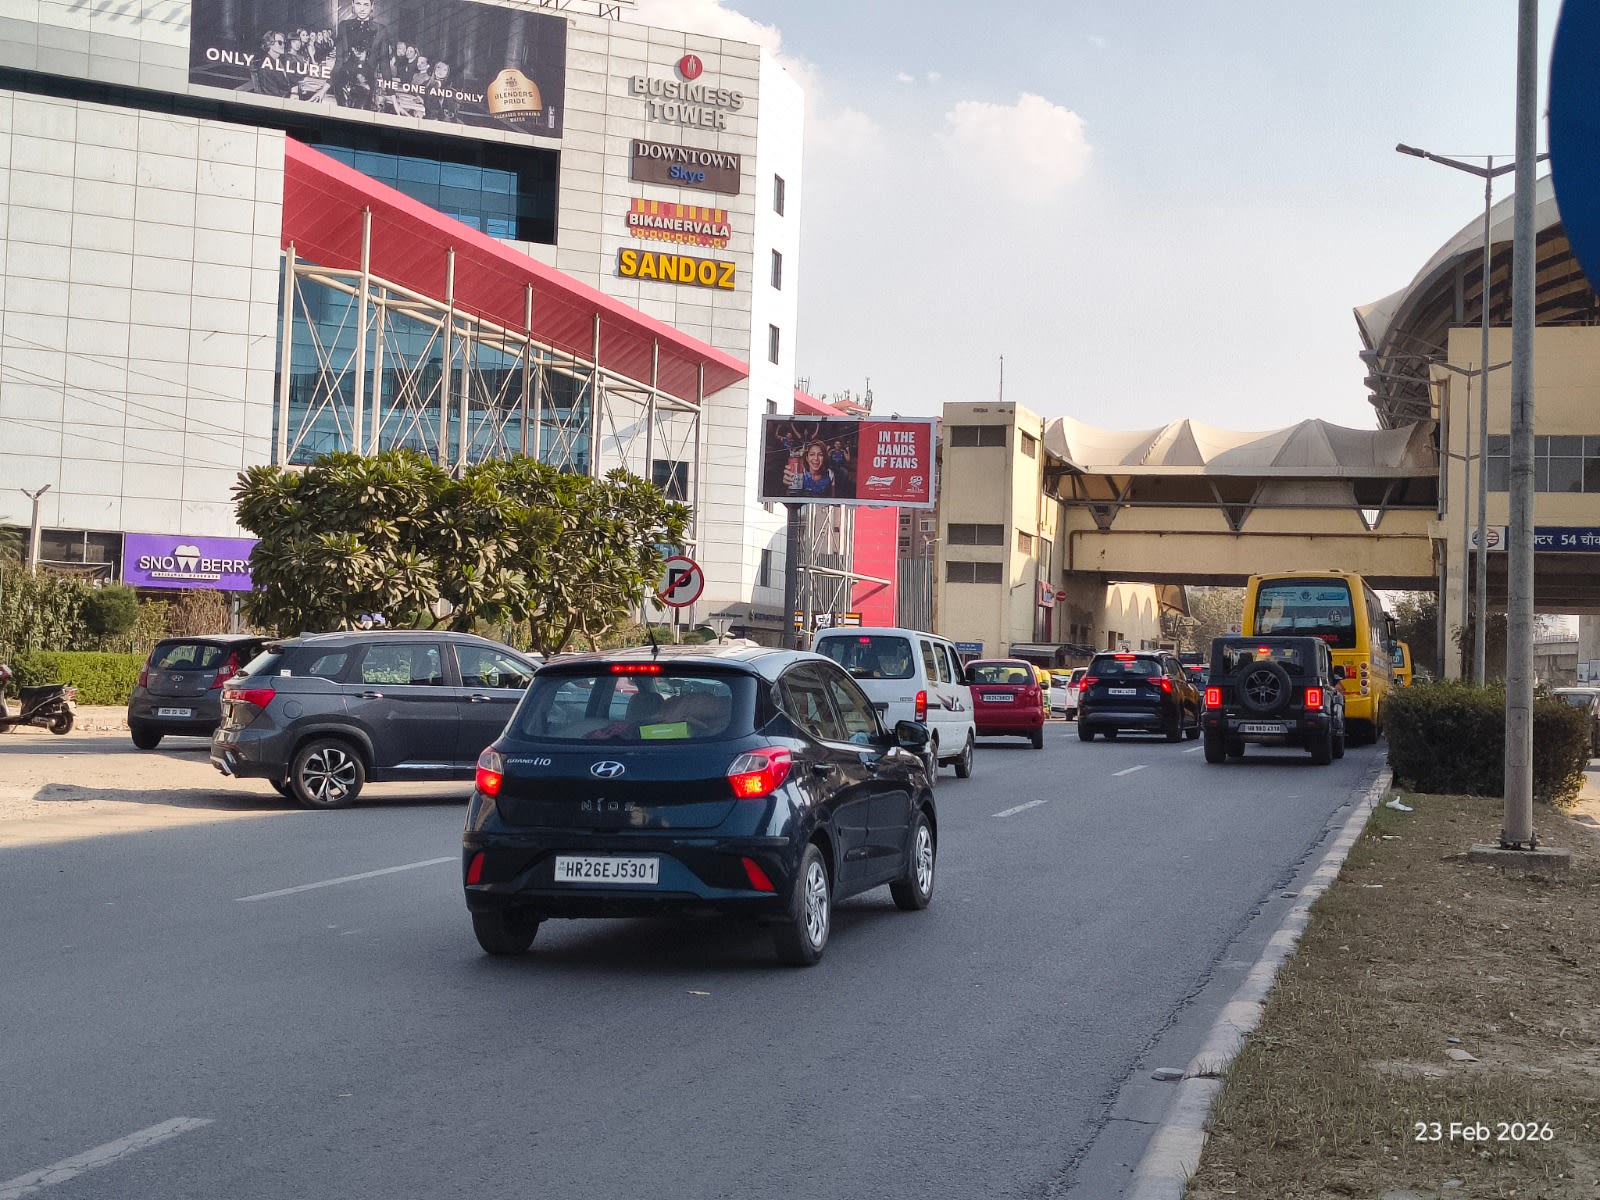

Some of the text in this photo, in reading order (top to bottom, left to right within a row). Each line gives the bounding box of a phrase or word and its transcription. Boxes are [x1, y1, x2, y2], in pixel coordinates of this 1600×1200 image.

[206, 47, 331, 79] ONLY ALLURE
[377, 78, 484, 103] THE ONE AND ONLY
[633, 75, 745, 110] BUSINESS
[649, 99, 727, 130] TOWER
[638, 142, 738, 170] DOWNTOWN
[670, 164, 705, 184] Skye
[629, 213, 730, 237] BIKANERVALA
[620, 249, 736, 288] SANDOZ
[878, 430, 916, 443] IN THE
[877, 443, 916, 456] HANDS
[872, 456, 918, 469] OF FANS
[1561, 534, 1577, 545] 54
[668, 568, 692, 598] P
[566, 861, 654, 879] HR26EJ5301
